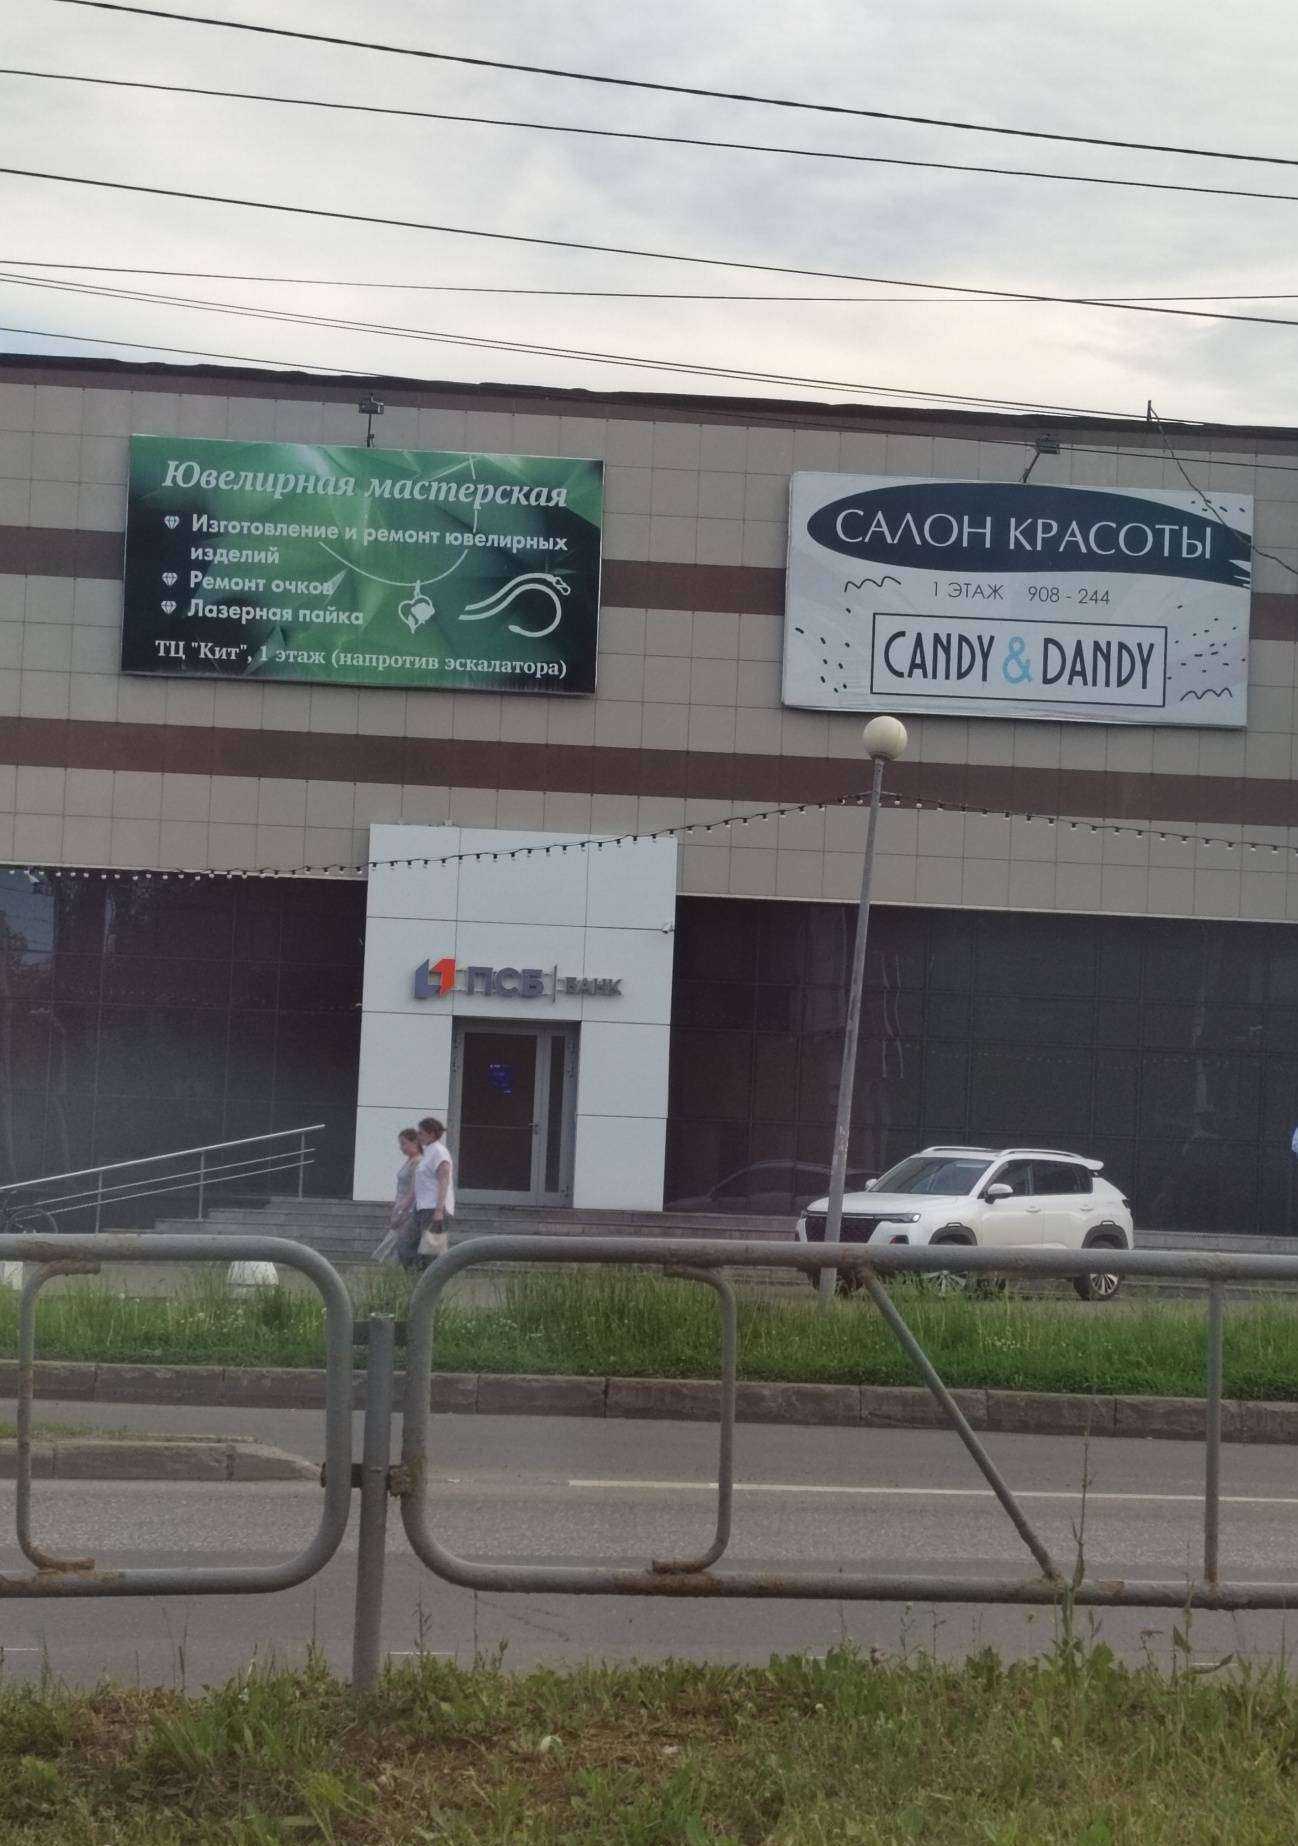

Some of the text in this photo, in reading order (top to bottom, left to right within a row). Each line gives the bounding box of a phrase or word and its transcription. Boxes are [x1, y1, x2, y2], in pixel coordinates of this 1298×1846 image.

[162, 460, 568, 508] Ювелирная мастерская
[191, 514, 568, 551] Изготовление и ремонт ювелирных
[835, 509, 1212, 559] САЛОН КРАСОТЫ
[190, 545, 280, 565] изделий
[190, 570, 335, 596] Ремонт очков
[933, 581, 939, 598] 1
[948, 582, 1004, 600] ЭТАЖ
[188, 598, 364, 625] Лазерная пайка
[156, 640, 186, 661] ТЦ
[260, 645, 269, 662] 1
[276, 648, 325, 665] этаж
[331, 650, 439, 672] (напротив
[445, 656, 567, 678] эскалатора)
[884, 630, 1155, 689] CANDY & DANDY
[467, 966, 623, 997] ПСБ БАНК
